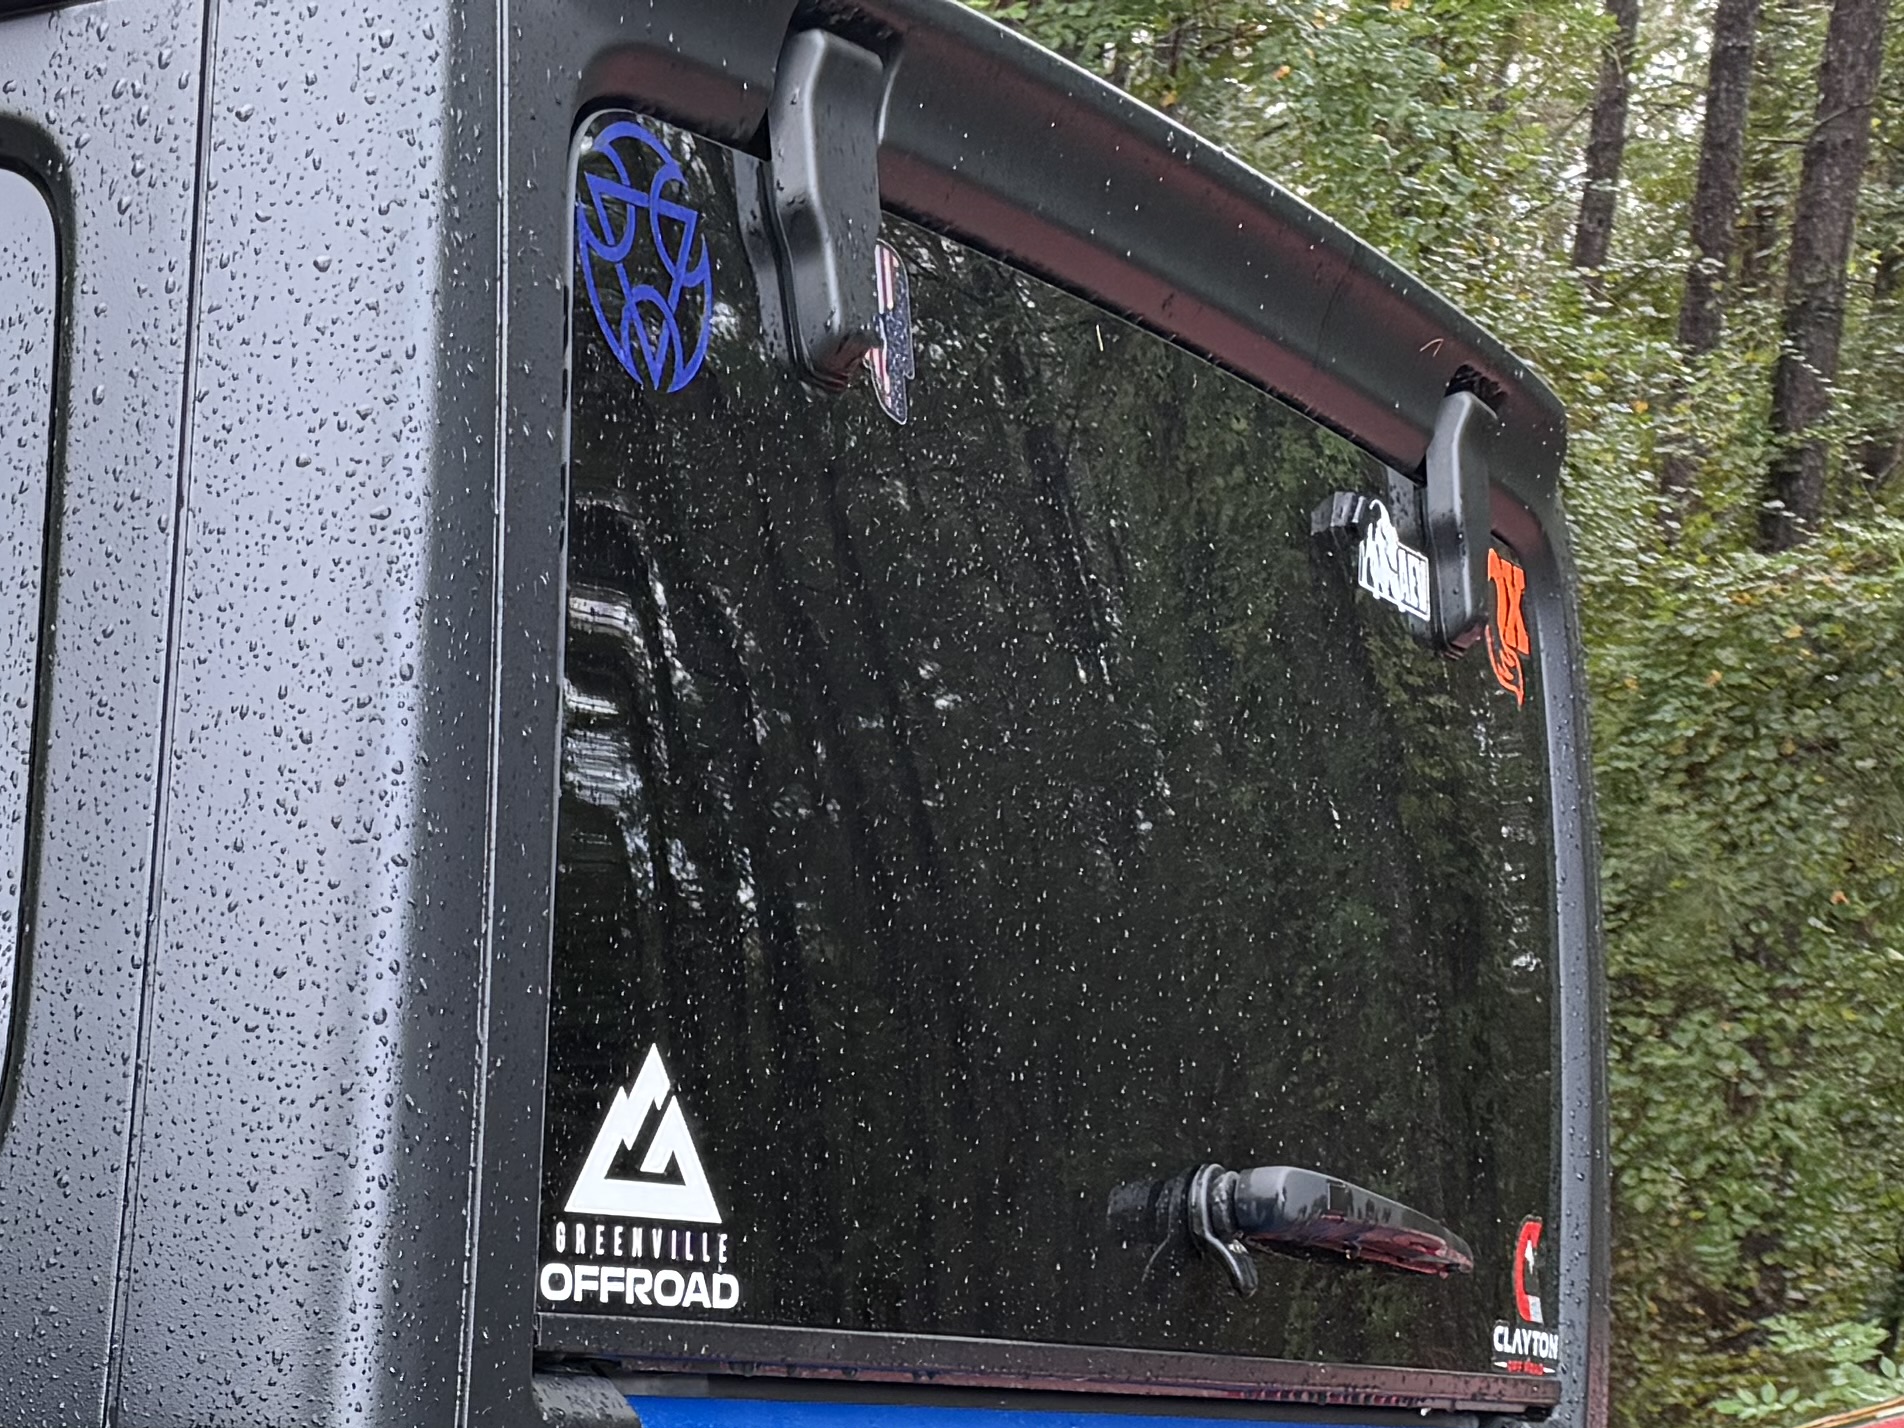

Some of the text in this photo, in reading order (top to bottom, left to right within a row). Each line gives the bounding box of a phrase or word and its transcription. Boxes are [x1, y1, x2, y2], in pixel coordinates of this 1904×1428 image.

[555, 1221, 728, 1264] GREENVILLE
[539, 1262, 740, 1310] OFFROAD
[1493, 1324, 1559, 1359] CLAYTON
